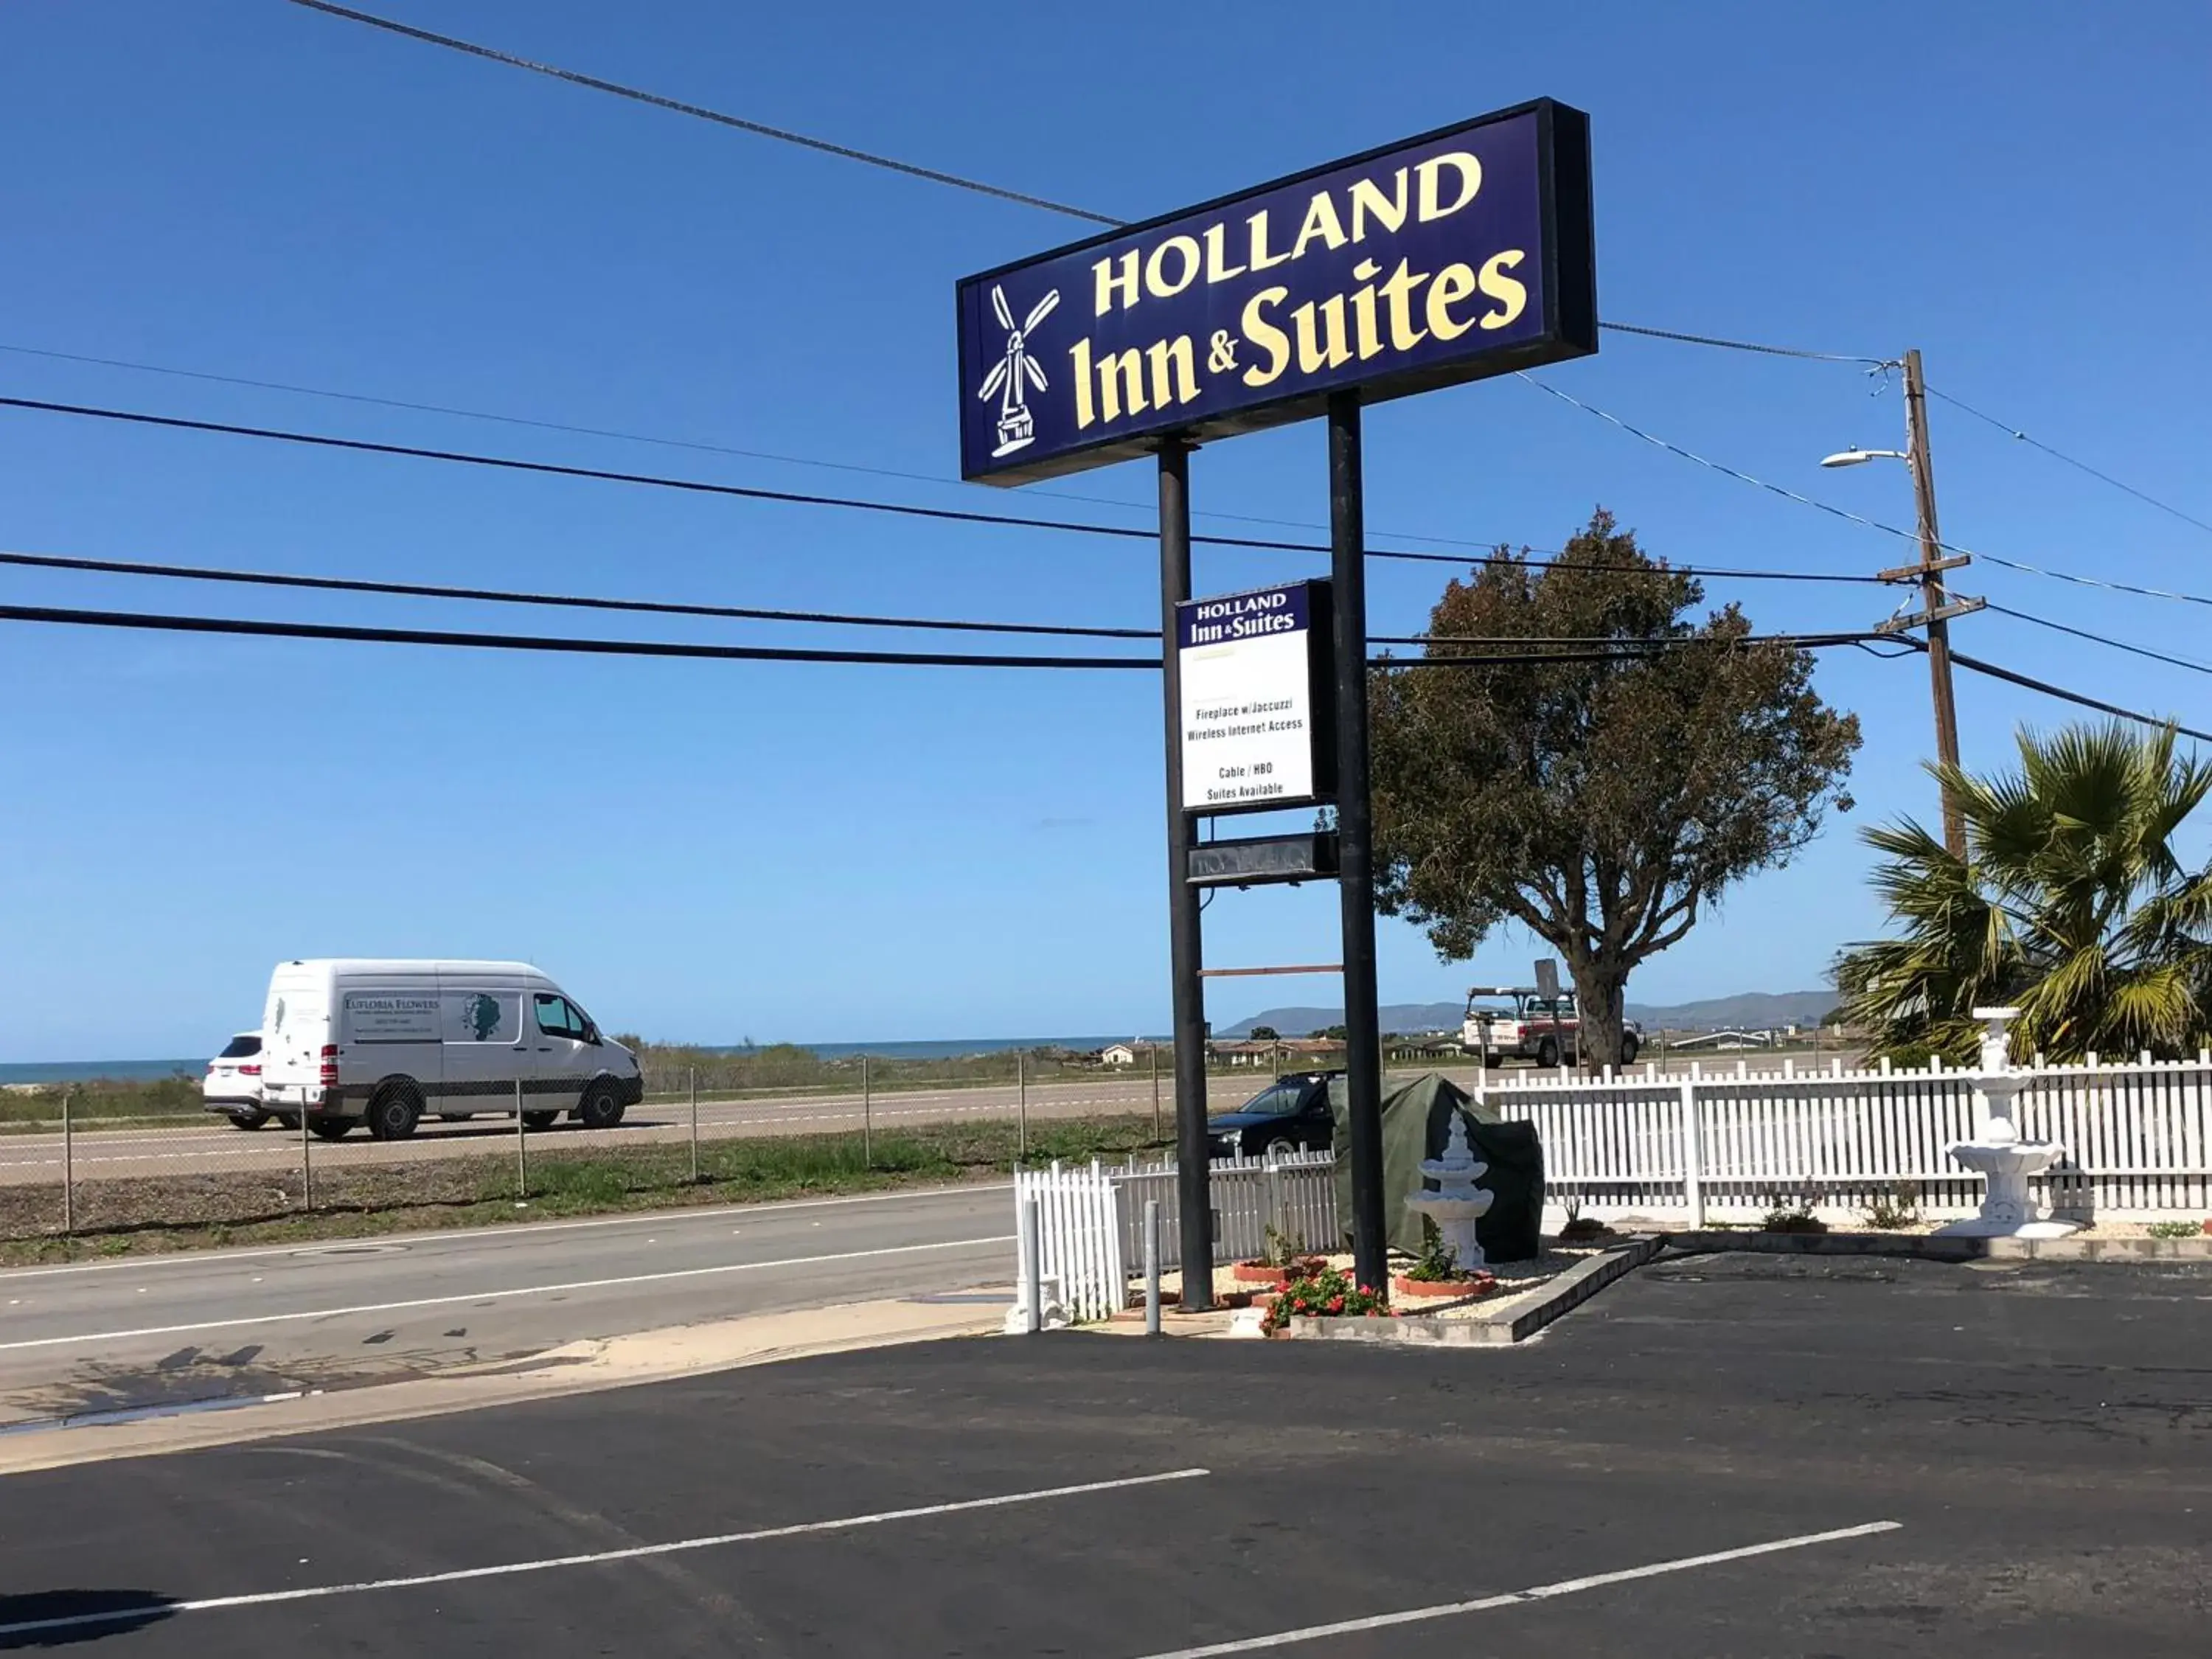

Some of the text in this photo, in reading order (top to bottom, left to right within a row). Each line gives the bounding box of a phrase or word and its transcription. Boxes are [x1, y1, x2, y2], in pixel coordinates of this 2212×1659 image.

[1092, 152, 1482, 316] HOLLAND
[1070, 248, 1526, 429] Inn & Suites
[1197, 594, 1287, 620] HOLLAND
[1191, 612, 1294, 643] Inn & Suites
[1196, 706, 1239, 720] Fireplace
[1188, 719, 1303, 741] Wireless Internet Access
[1220, 766, 1245, 779] Cable
[1253, 762, 1273, 775] HBO
[1207, 782, 1284, 800] Suites Available
[396, 999, 439, 1009] FLOWERS
